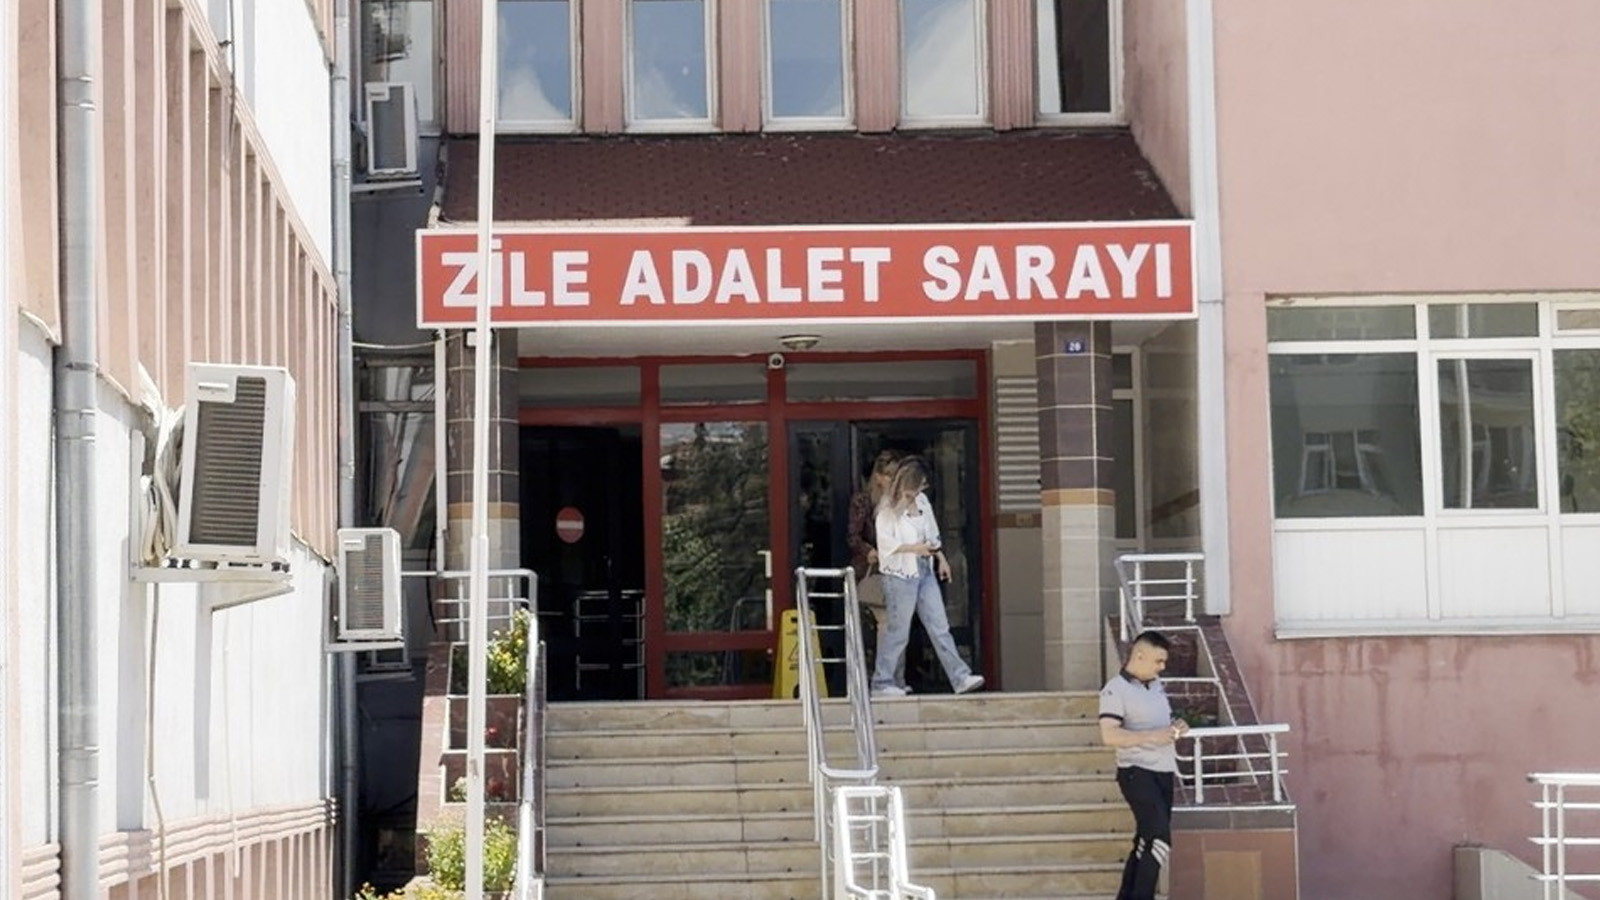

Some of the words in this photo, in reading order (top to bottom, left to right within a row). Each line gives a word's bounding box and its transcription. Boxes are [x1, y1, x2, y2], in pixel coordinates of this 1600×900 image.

[441, 238, 590, 307] ZİLE
[619, 247, 892, 305] ADALET
[922, 242, 1173, 302] SARAYI
